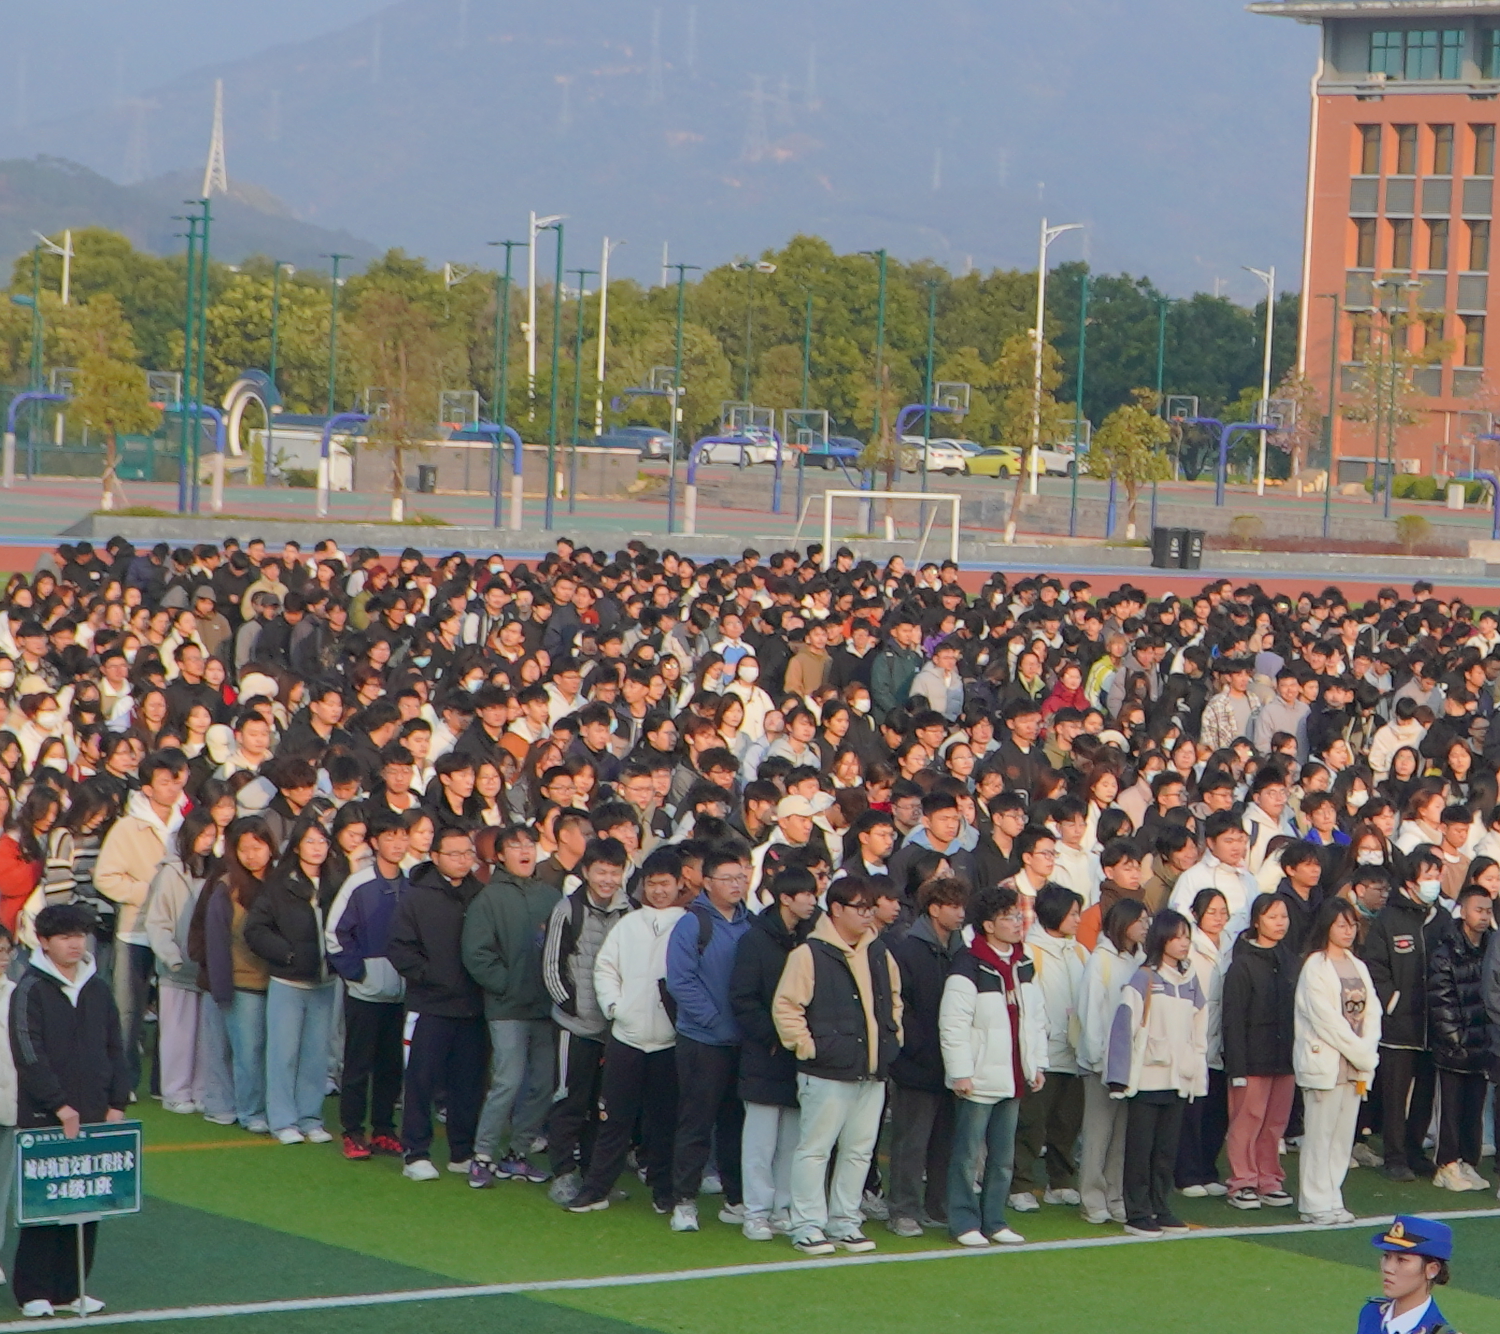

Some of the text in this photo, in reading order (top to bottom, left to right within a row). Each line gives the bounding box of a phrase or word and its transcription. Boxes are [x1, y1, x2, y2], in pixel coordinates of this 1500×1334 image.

[24, 1151, 134, 1179] 城市轨道交通工程技术
[46, 1176, 112, 1199] 24级1班
